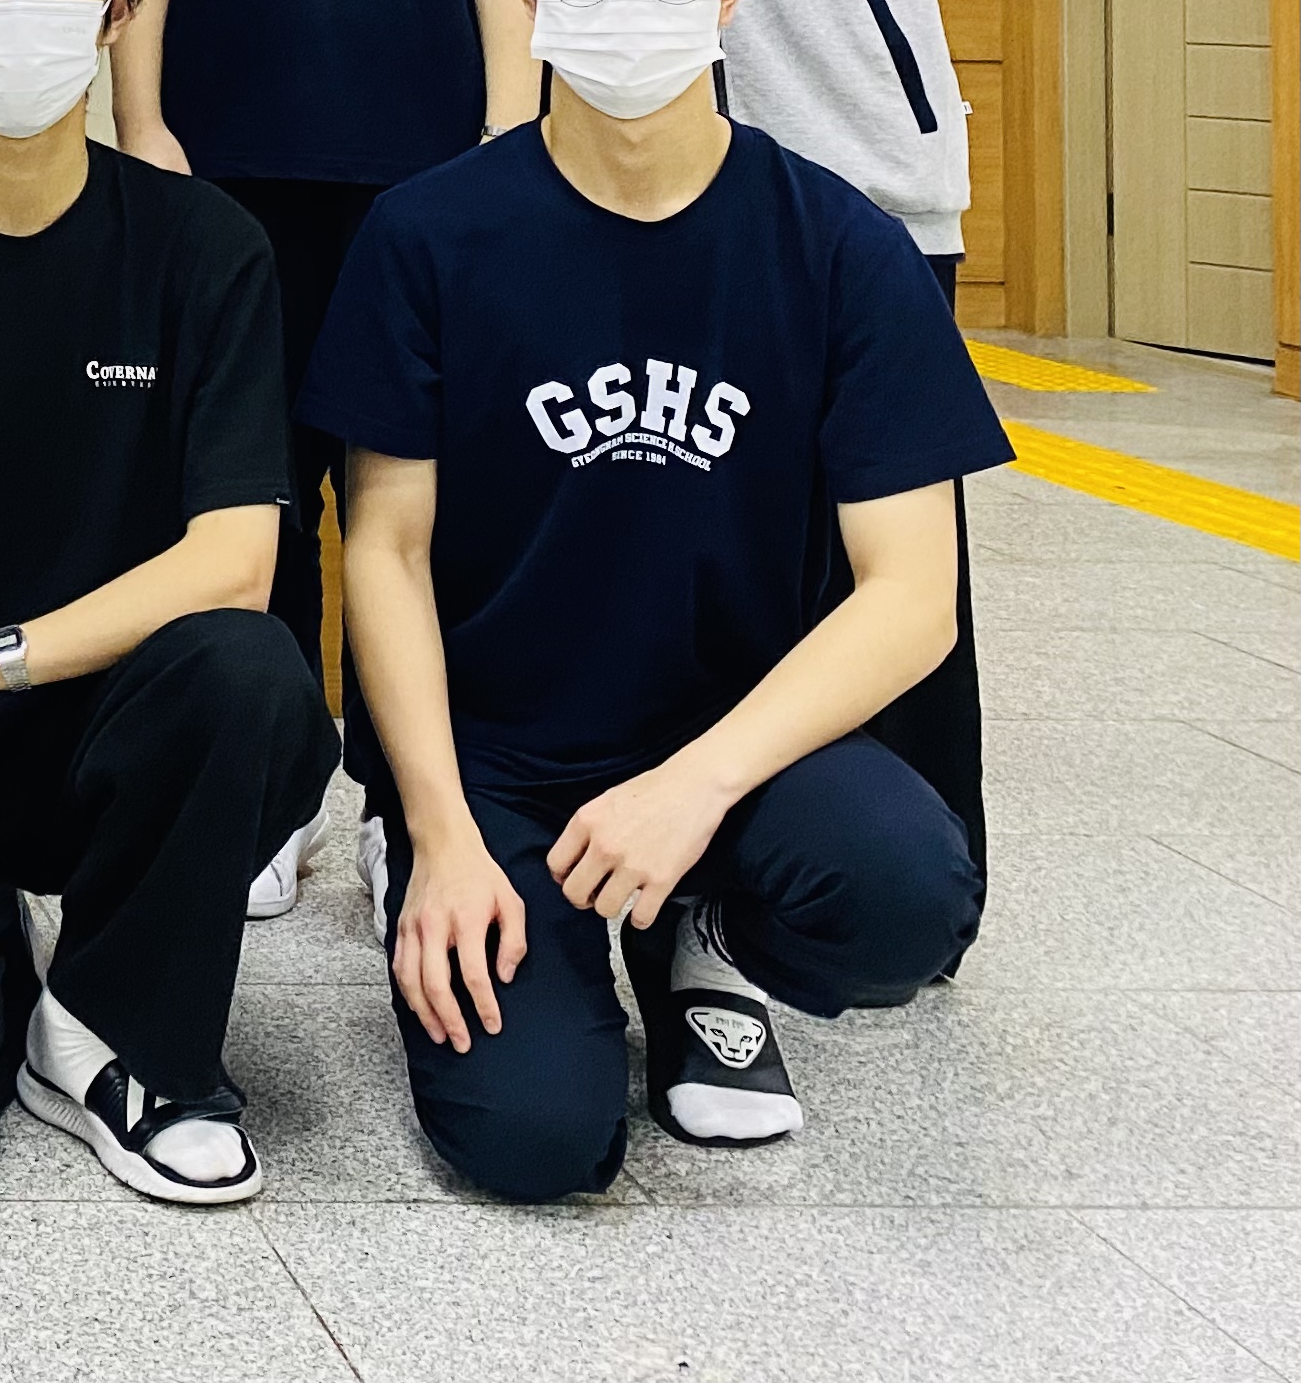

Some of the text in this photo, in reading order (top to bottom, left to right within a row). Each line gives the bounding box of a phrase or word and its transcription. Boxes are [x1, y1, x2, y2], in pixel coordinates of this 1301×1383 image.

[85, 360, 158, 380] COVERNA
[525, 358, 751, 458] GSHS
[624, 432, 669, 450] SCIENCE
[611, 449, 644, 462] SINCE
